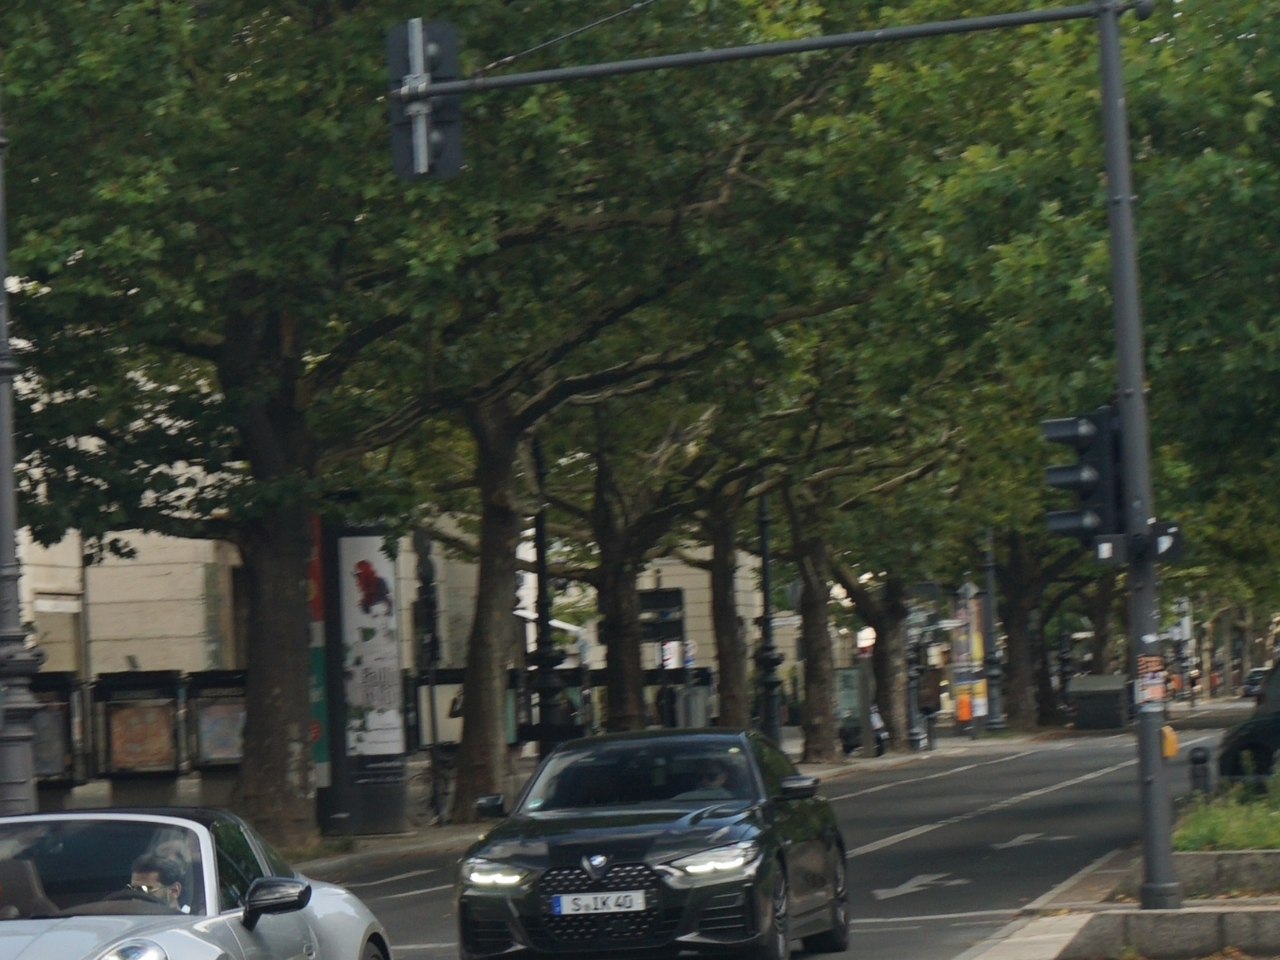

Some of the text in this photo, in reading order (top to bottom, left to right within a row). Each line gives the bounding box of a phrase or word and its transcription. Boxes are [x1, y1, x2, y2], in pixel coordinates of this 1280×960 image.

[571, 897, 582, 912] S
[592, 896, 612, 911] IK
[613, 894, 634, 909] 40
